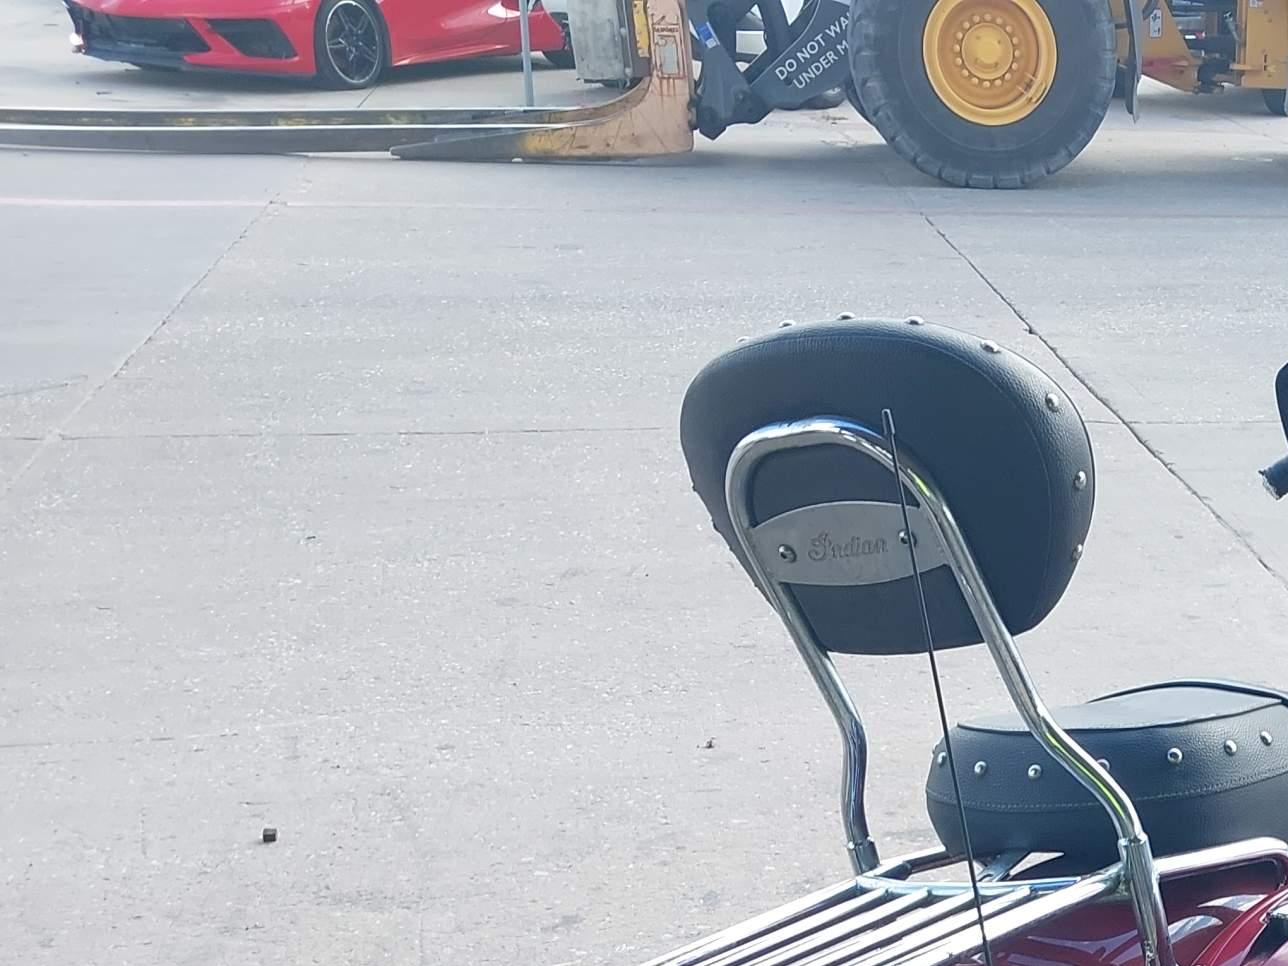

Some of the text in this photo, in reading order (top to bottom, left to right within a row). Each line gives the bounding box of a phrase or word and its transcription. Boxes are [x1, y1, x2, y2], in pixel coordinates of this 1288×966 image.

[775, 12, 850, 80] DO NOT WA
[793, 50, 838, 89] UNDER
[807, 531, 889, 561] Indian
